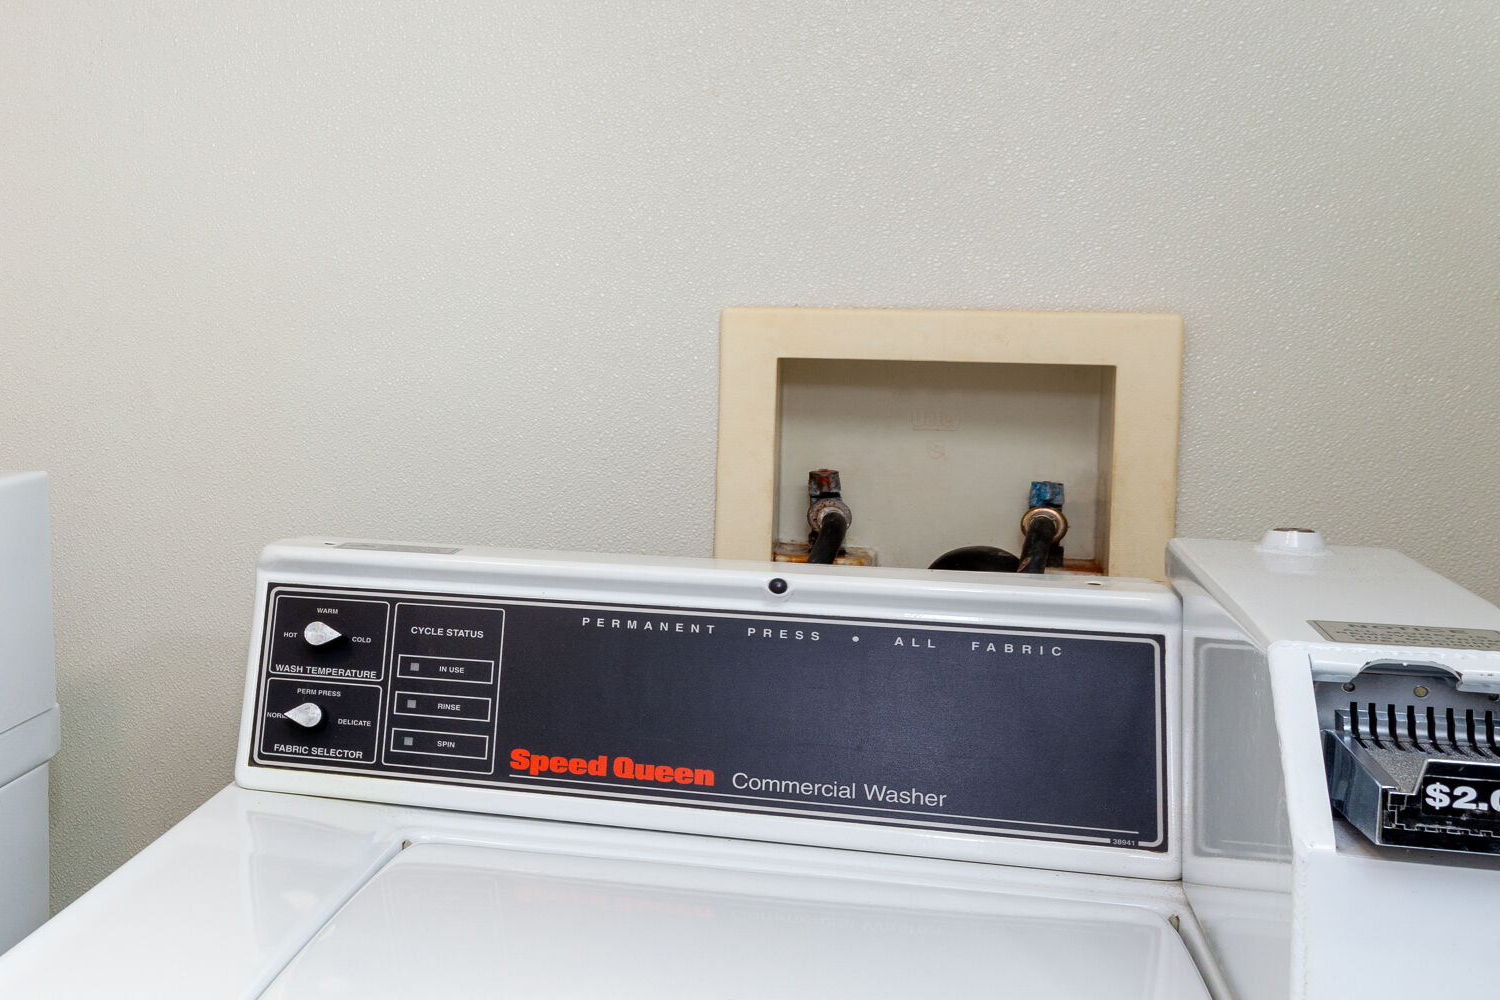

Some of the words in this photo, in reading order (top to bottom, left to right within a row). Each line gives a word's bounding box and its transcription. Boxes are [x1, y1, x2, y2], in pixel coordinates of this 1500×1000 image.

[317, 607, 339, 615] WARM
[410, 626, 444, 636] CYCLE
[446, 628, 484, 639] STATUS
[582, 617, 716, 635] PERMANENT
[747, 627, 821, 641] PRESS
[894, 636, 936, 649] ALL
[971, 641, 1063, 657] FABRIC
[275, 663, 303, 673] WASH
[306, 666, 377, 679] TEMPERATURE
[449, 666, 465, 674] USE
[437, 703, 461, 711] RINSE
[337, 718, 372, 727] DELICATE
[437, 740, 456, 748] SPIN
[274, 744, 309, 754] FABRIC
[311, 747, 363, 759] SELECTOR
[509, 748, 608, 776] Speed
[613, 756, 715, 787] Queen
[732, 772, 856, 799] Commercial
[864, 783, 947, 807] Washer
